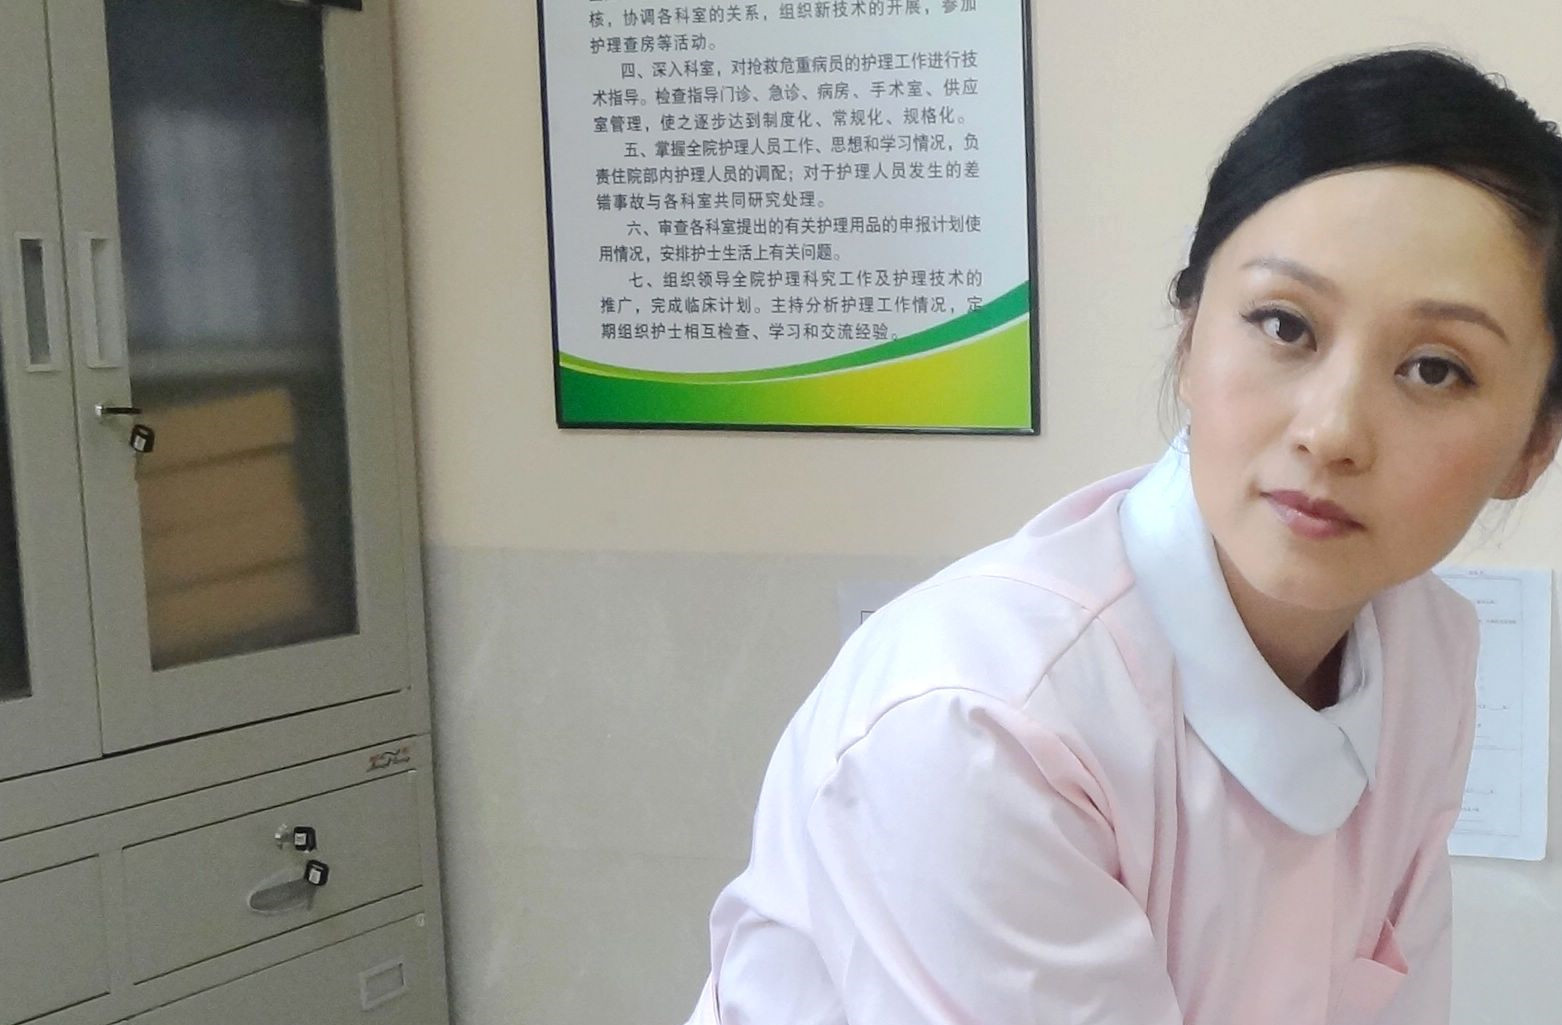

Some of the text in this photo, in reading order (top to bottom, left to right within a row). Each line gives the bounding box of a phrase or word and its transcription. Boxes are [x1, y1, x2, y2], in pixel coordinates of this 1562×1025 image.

[590, 33, 717, 54] 护理查房等活动。
